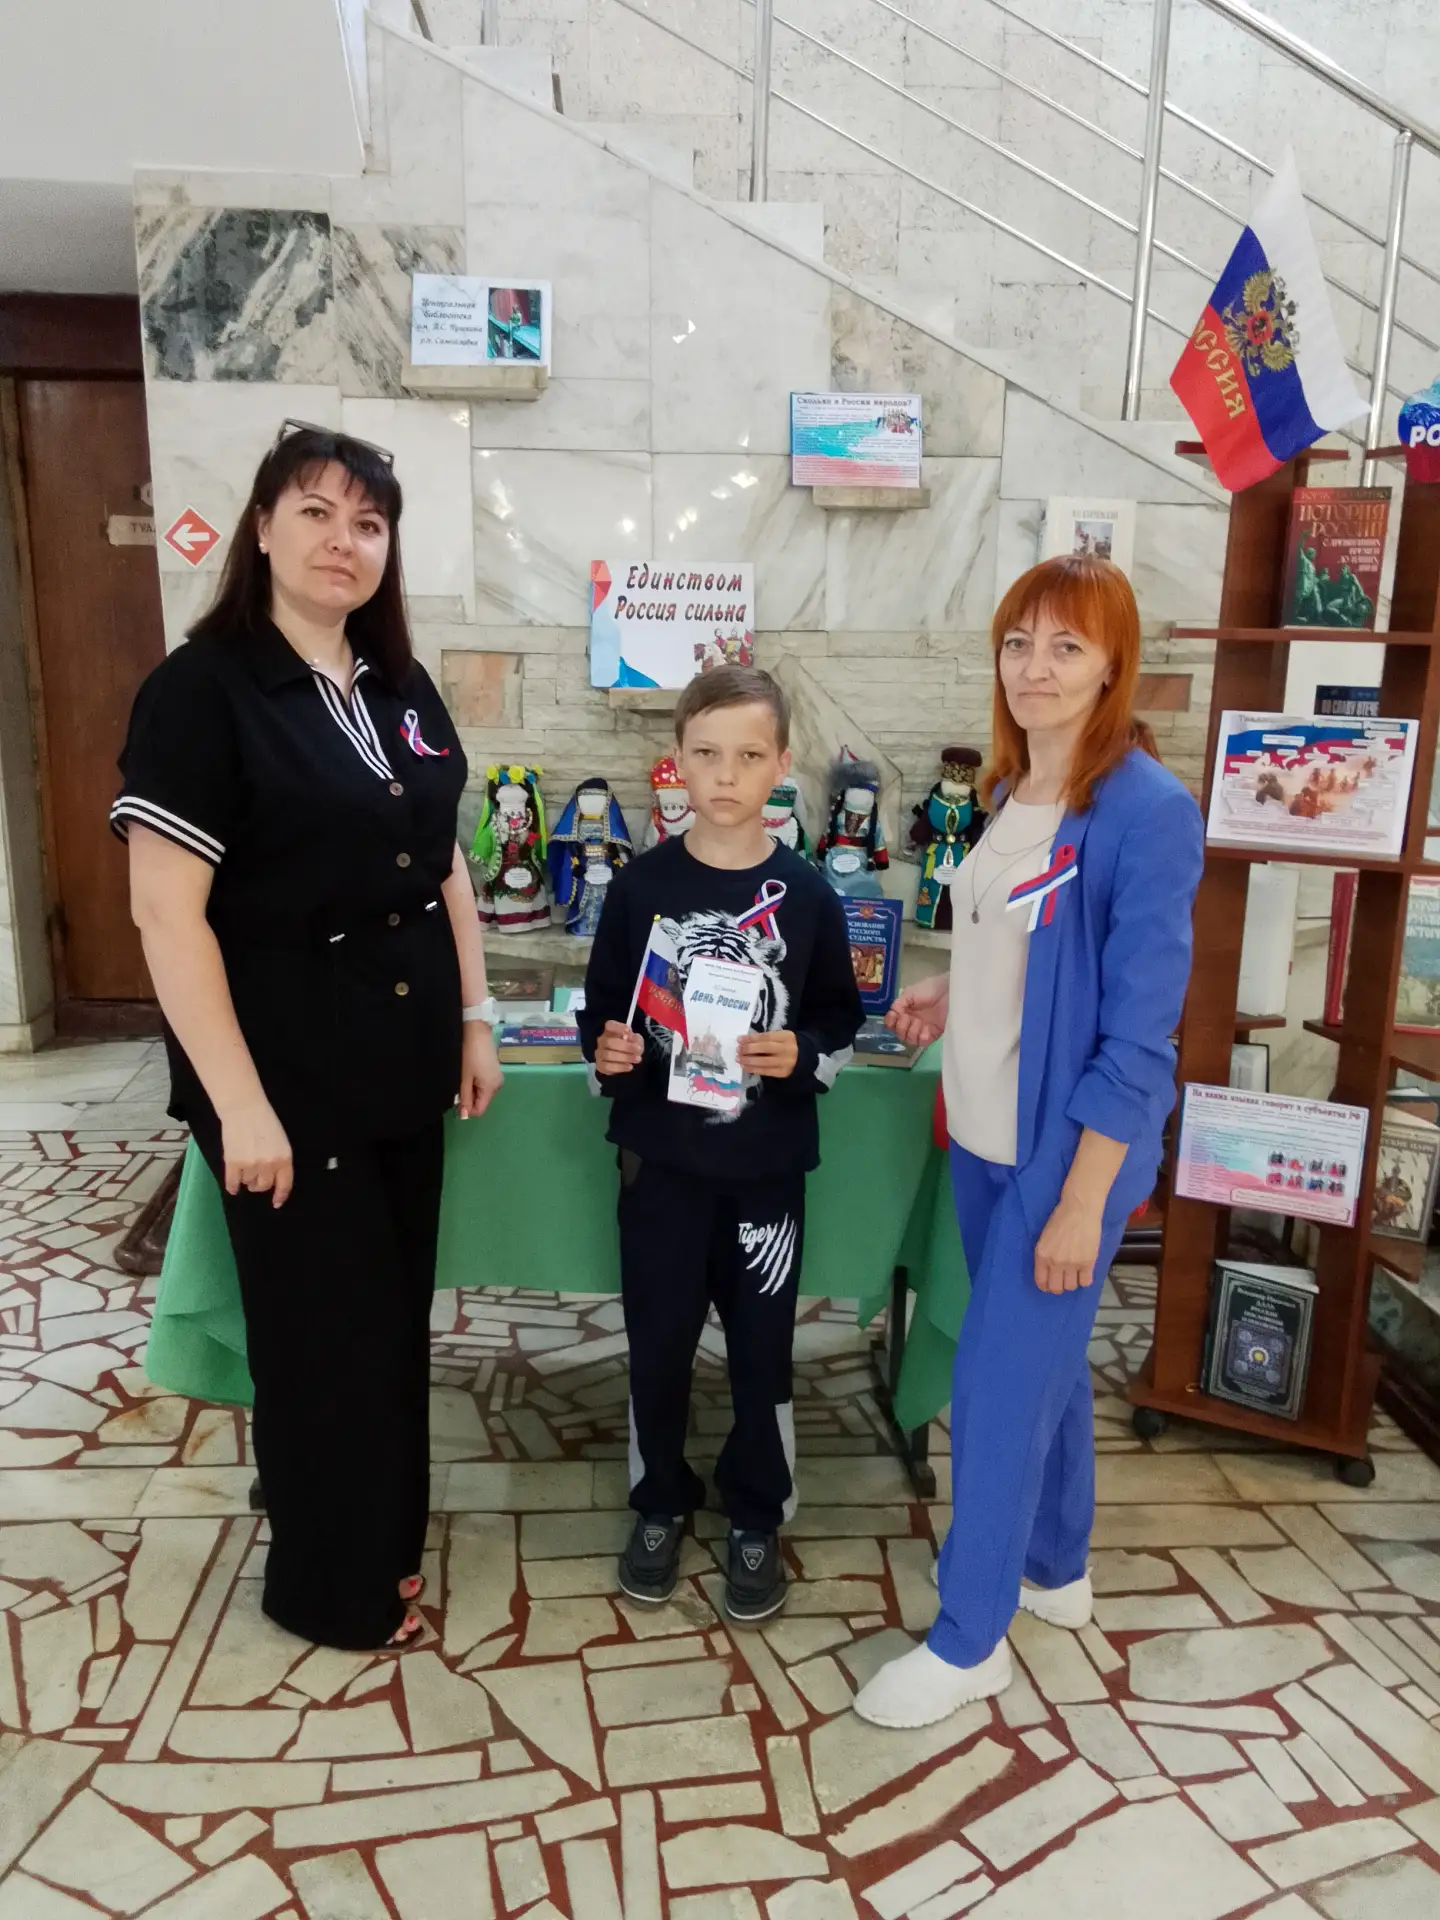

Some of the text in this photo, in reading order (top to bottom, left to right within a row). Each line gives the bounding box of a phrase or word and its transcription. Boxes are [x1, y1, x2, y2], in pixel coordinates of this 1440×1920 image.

[796, 396, 832, 406] Сколько
[841, 398, 871, 406] России
[626, 563, 743, 592] Единством
[614, 595, 747, 622] Россия сильна
[690, 989, 751, 1012] День России
[1192, 1087, 1202, 1097] На
[738, 1222, 775, 1253] Tiger
